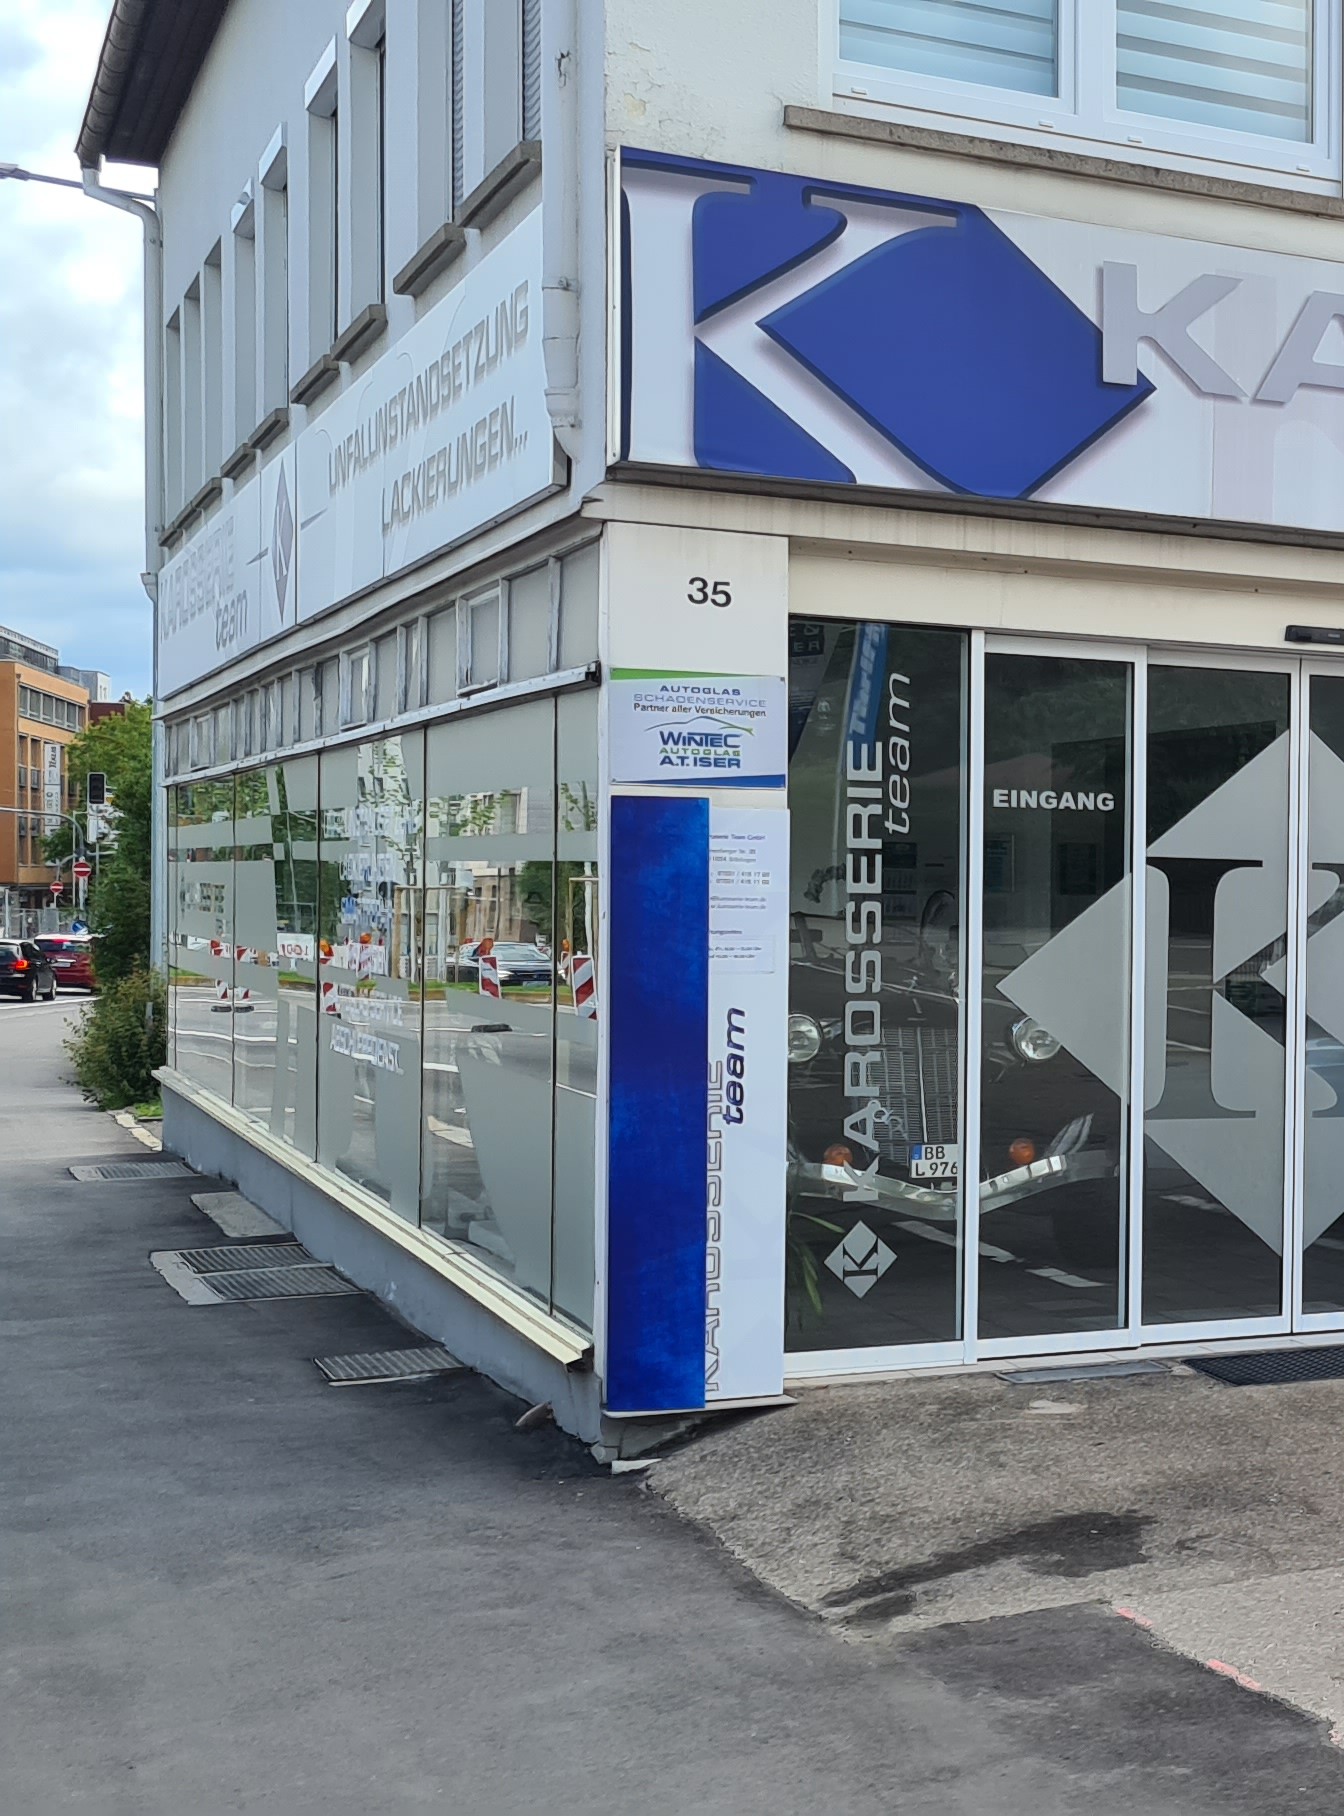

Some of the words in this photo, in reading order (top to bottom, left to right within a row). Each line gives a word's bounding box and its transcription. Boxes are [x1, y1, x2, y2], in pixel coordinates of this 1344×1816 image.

[329, 280, 529, 497] UNFALLINSTANDSETZUNG
[687, 576, 732, 608] 35
[215, 588, 248, 652] team
[660, 685, 741, 696] AUTOGLAS
[633, 703, 669, 714] Partner
[671, 705, 692, 714] aller
[695, 706, 766, 719] Versicherungen
[693, 756, 741, 769] ISER
[884, 672, 911, 835] team
[992, 788, 1115, 812] EINGANG
[843, 741, 883, 1202] KAROSSERIE
[723, 1006, 746, 1127] team
[924, 1146, 945, 1161] BB
[915, 1163, 924, 1178] L
[928, 1162, 958, 1178] 976
